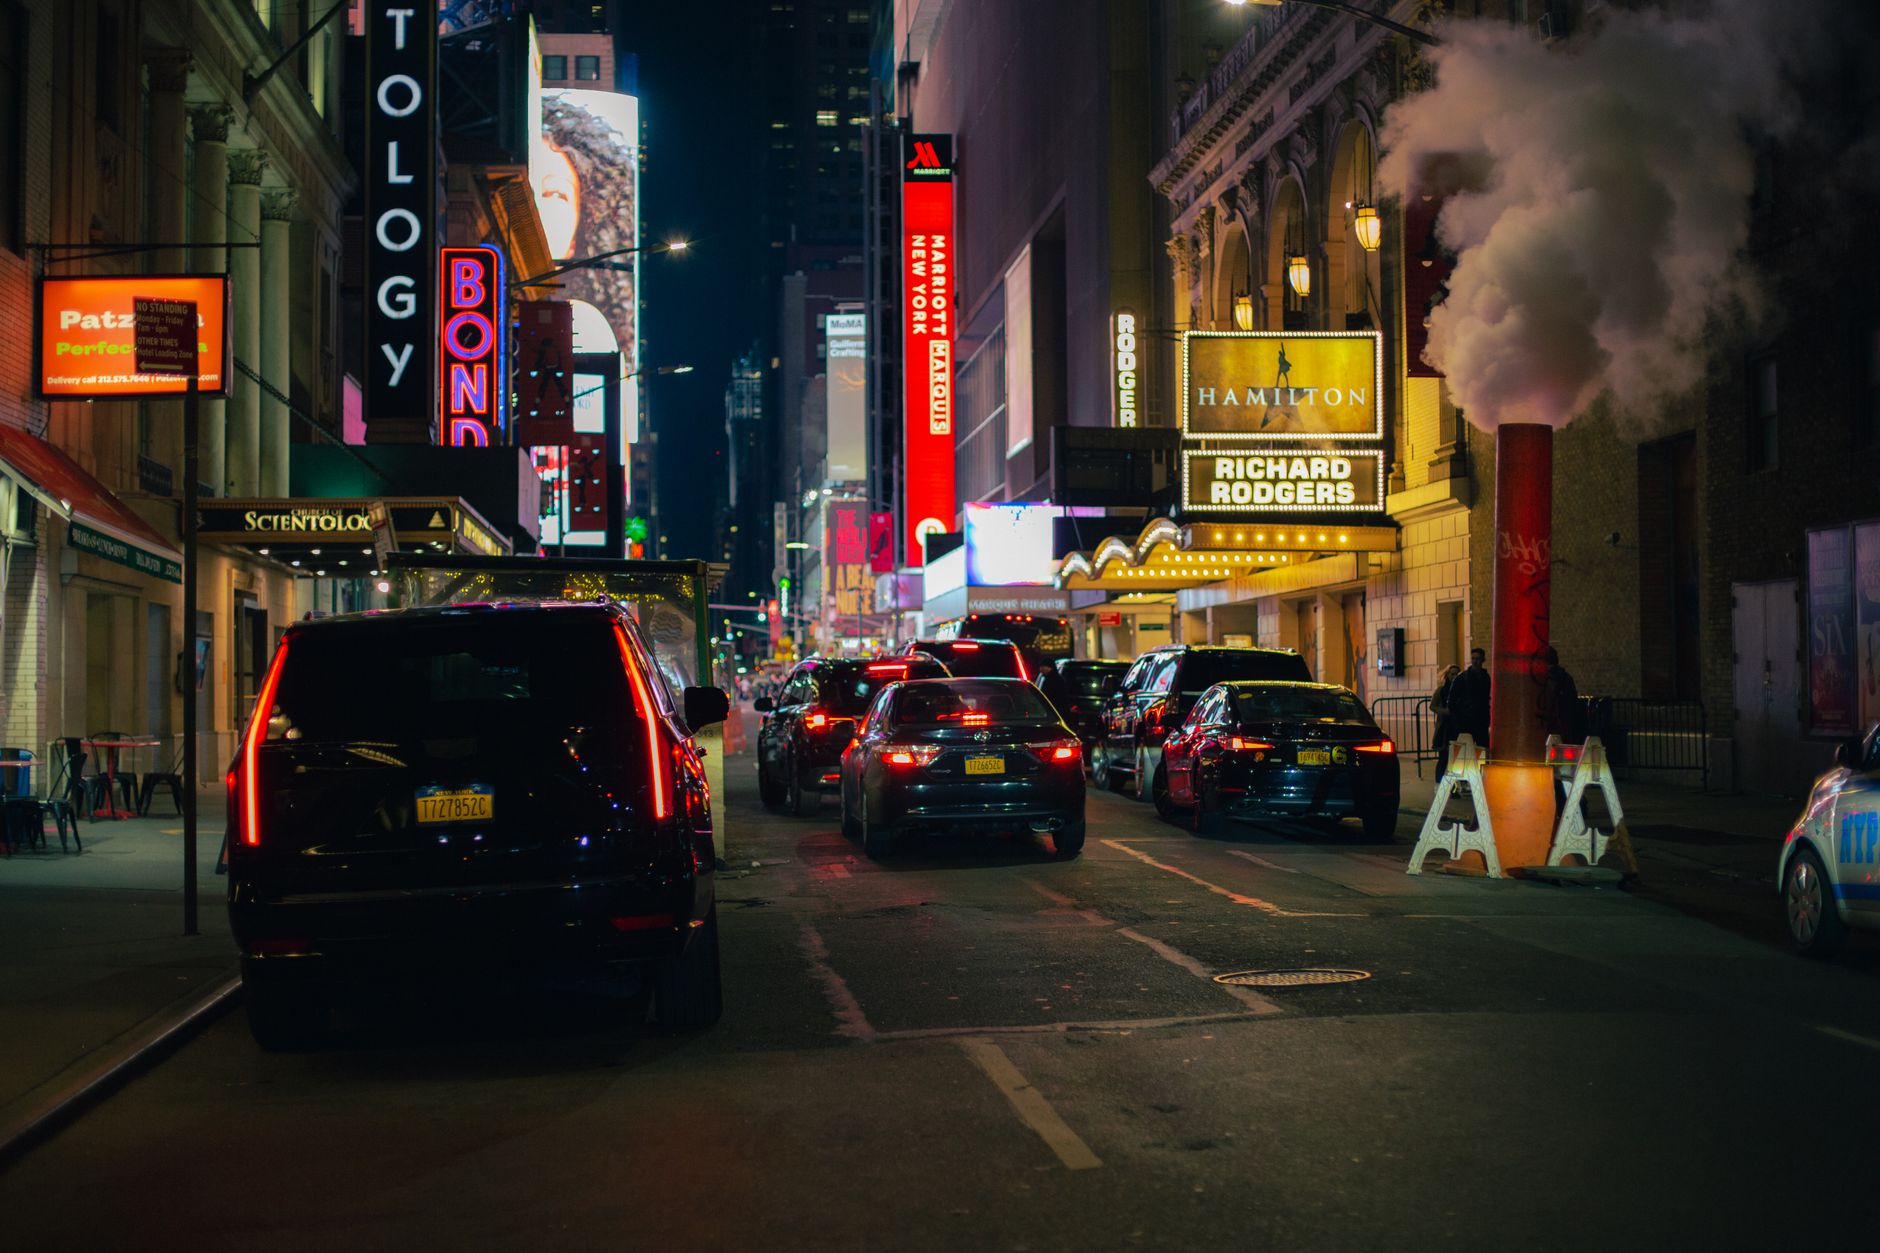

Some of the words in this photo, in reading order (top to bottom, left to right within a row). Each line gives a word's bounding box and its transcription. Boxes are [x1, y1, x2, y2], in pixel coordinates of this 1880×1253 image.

[377, 9, 421, 386] TOLOGY
[912, 235, 926, 277] NEW
[930, 235, 947, 336] MARRIOTT
[136, 302, 148, 313] NO
[149, 303, 189, 316] STANDING
[912, 283, 928, 334] YORK
[166, 316, 184, 327] Friday
[830, 320, 862, 329] MoMA
[56, 341, 136, 356] Perfec
[138, 337, 159, 346] OTHER
[160, 338, 179, 348] TIMES
[445, 257, 493, 447] BOND
[46, 376, 80, 387] Delivery
[82, 375, 97, 385] call
[1117, 314, 1136, 428] RODGER
[932, 342, 947, 432] MARQUIS
[1198, 387, 1366, 406] HAMILTON
[1215, 457, 1351, 480] RICHARD
[1211, 480, 1356, 505] RODGERS
[291, 508, 329, 517] CHURCH
[423, 797, 486, 818] T727852C
[1841, 811, 1880, 863] NYP
